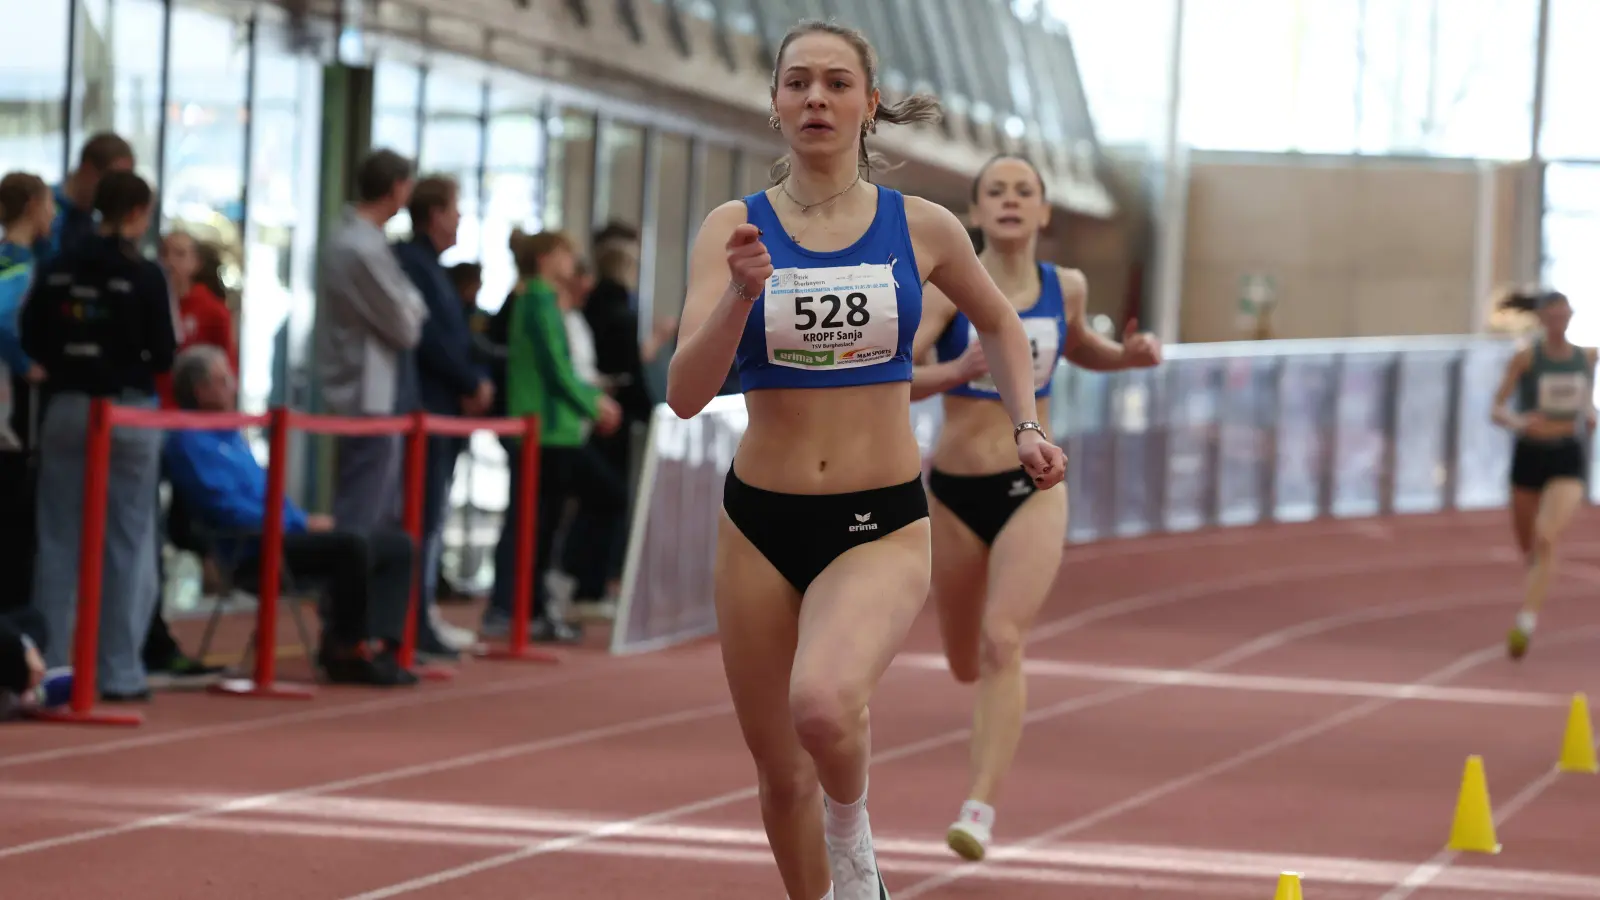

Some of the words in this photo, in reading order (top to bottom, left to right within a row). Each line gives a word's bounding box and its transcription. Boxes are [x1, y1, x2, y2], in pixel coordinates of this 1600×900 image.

[794, 292, 870, 331] 528
[803, 331, 835, 342] KROPF
[836, 329, 863, 341] Sanja
[780, 352, 813, 363] erima
[872, 348, 892, 356] SPORTS
[848, 522, 878, 532] erima
